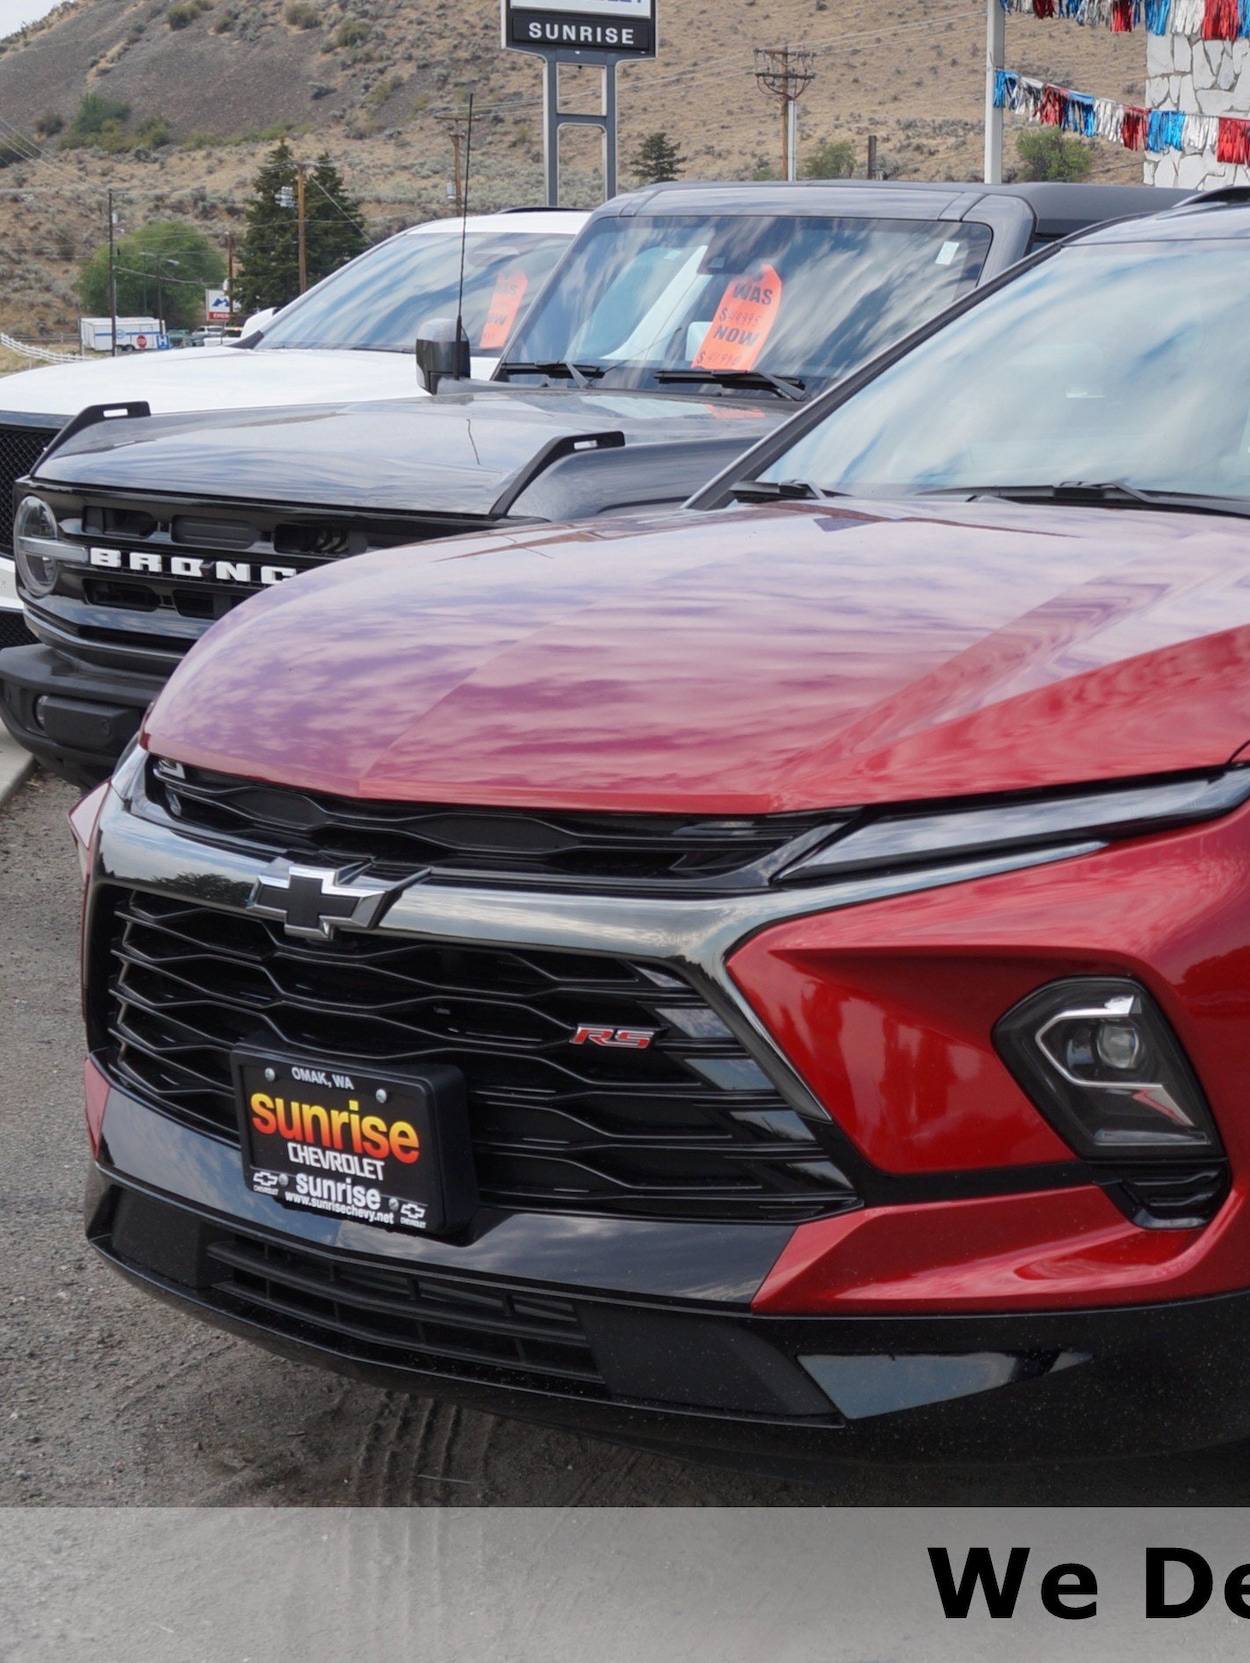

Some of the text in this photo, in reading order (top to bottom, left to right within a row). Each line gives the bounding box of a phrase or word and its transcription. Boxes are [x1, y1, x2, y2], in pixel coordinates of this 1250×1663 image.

[529, 22, 634, 44] SUNRISE
[732, 282, 773, 305] WAS
[158, 335, 168, 346] H
[713, 325, 761, 346] NOW
[90, 547, 297, 585] BRONC
[570, 1026, 654, 1049] RS
[292, 1067, 355, 1090] OMAK, WA
[287, 1142, 385, 1181] CHEVROLET
[285, 1191, 395, 1225] www.sunrisechevy.net
